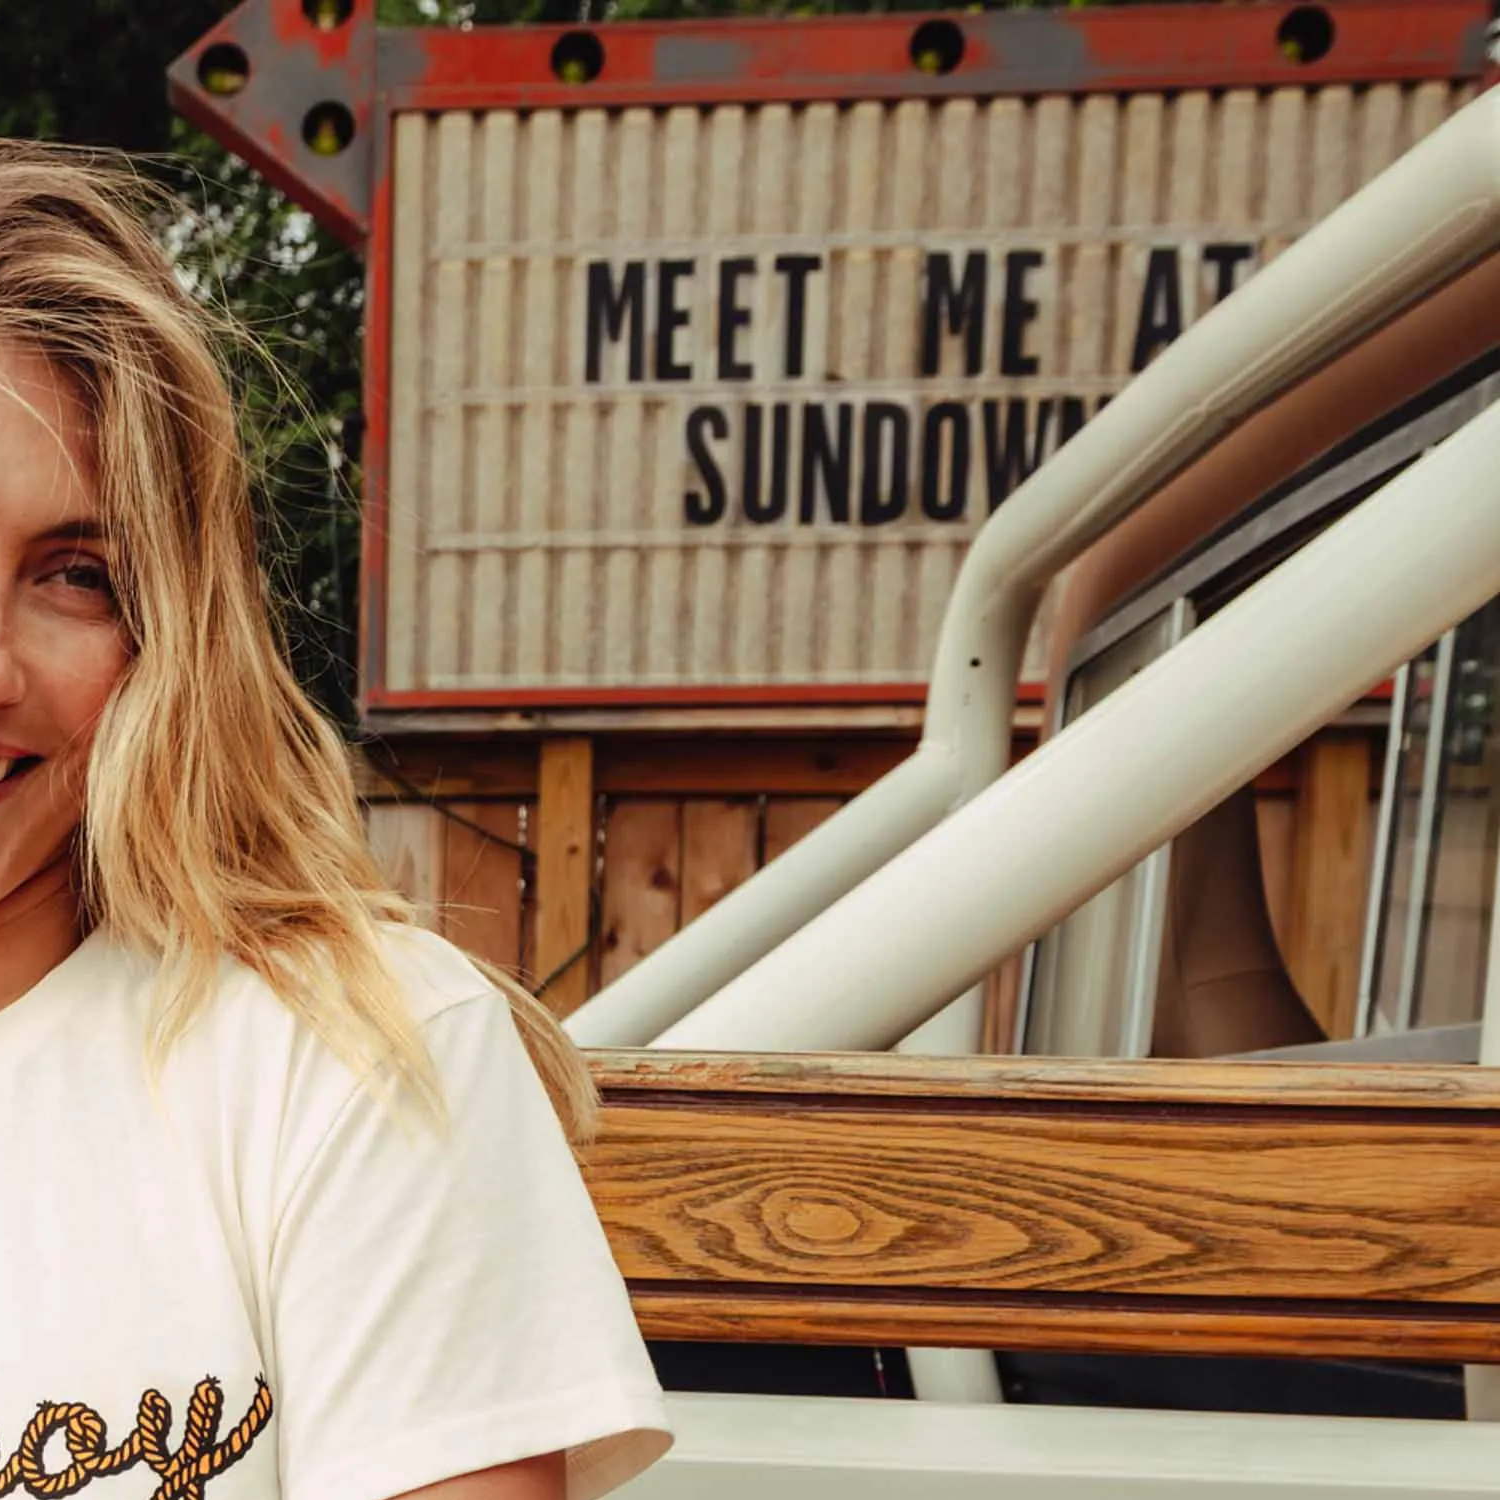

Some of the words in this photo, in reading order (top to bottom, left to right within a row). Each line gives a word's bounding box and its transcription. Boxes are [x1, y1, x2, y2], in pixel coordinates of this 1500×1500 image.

[585, 254, 821, 383] MEET
[922, 249, 1045, 377] ME
[1130, 243, 1254, 373] AT
[684, 395, 1114, 527] SUNDOW
